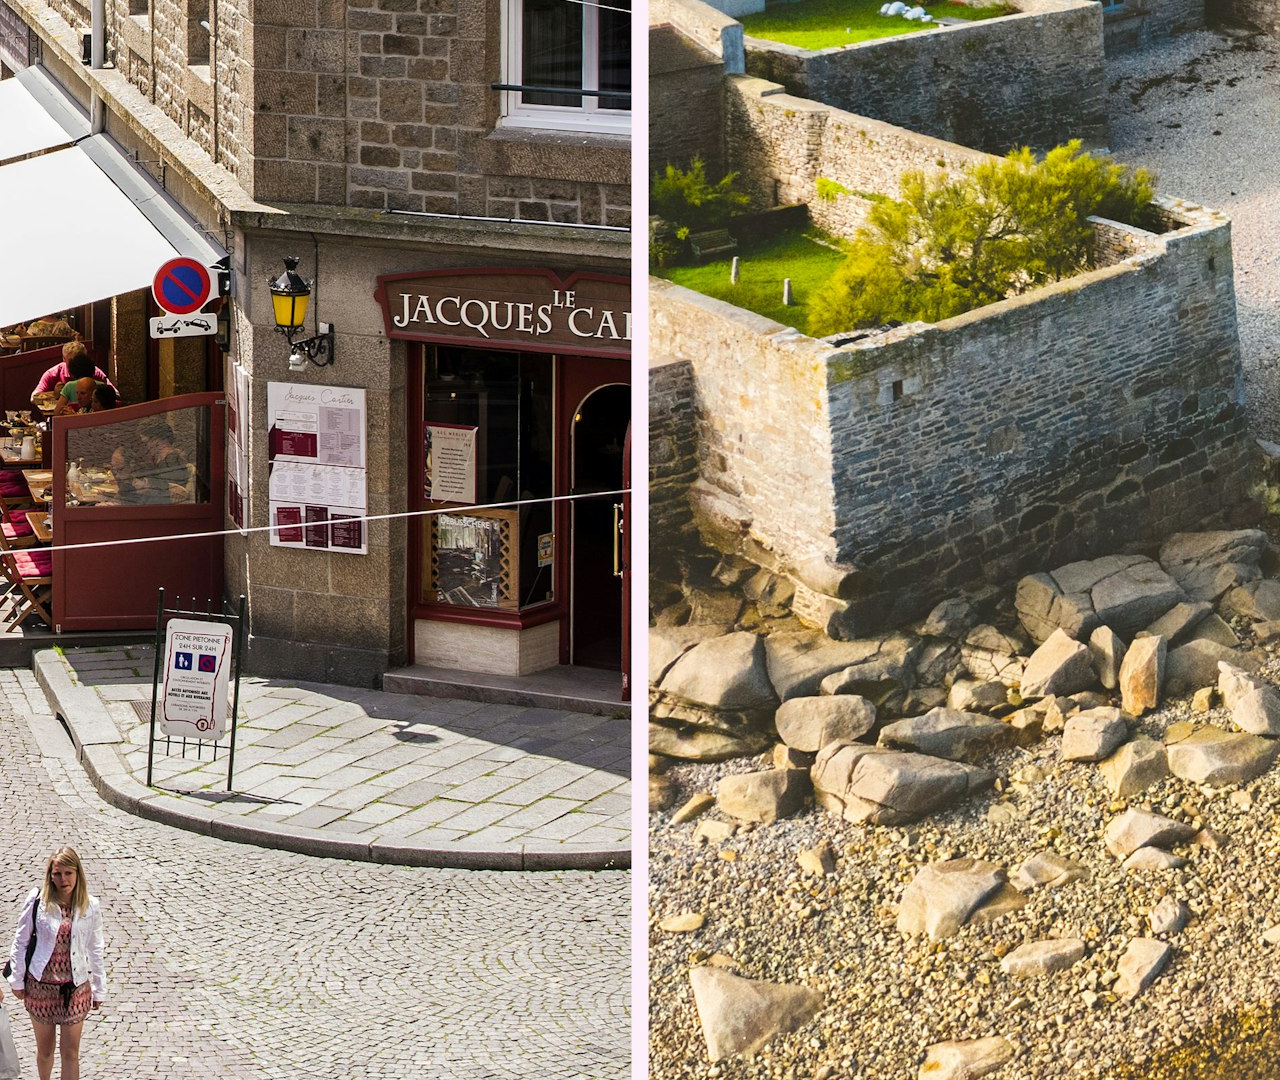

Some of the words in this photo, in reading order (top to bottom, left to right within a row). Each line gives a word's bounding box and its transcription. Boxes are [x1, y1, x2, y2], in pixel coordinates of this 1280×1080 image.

[553, 289, 576, 309] LE
[393, 293, 553, 338] JACQUES
[284, 385, 316, 404] Jacques
[320, 388, 355, 405] Cartier
